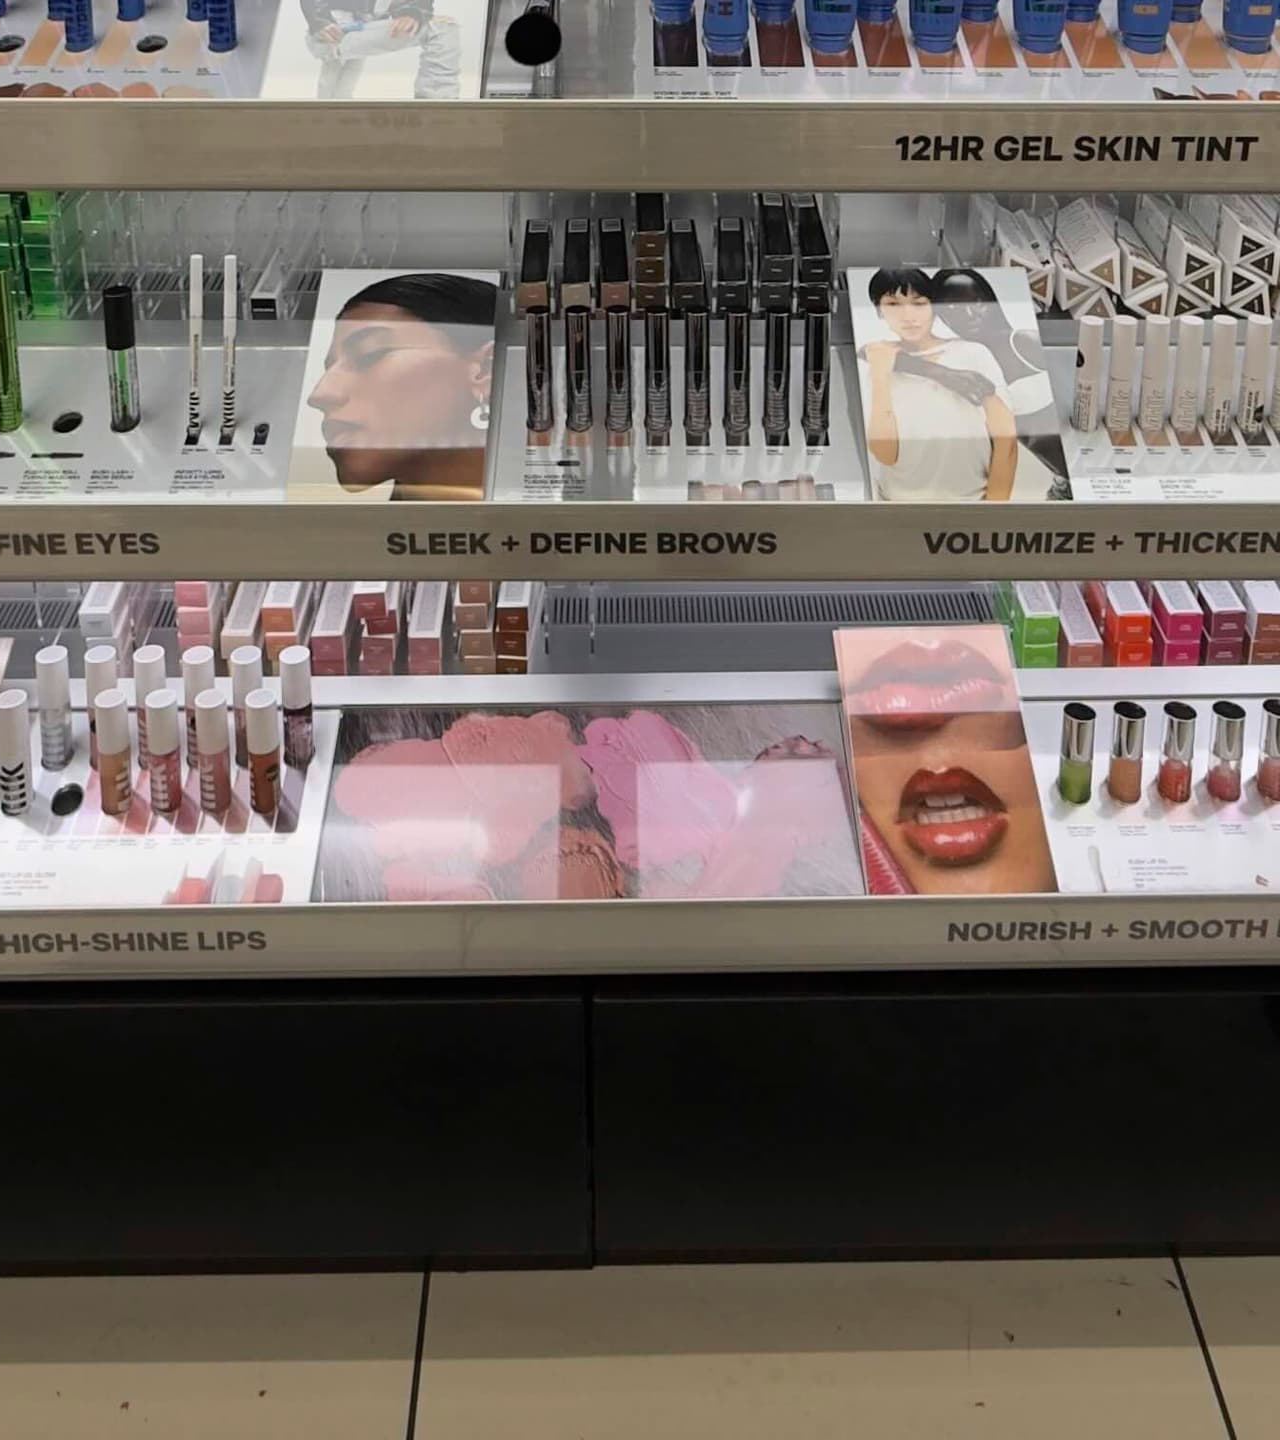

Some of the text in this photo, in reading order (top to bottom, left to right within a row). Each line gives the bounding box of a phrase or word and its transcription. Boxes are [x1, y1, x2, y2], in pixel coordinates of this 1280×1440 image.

[895, 135, 1260, 162] 12HR GEL SKIN TINT
[76, 532, 161, 555] EYES
[386, 532, 778, 555] SLEEK + DEFINE BROWS
[923, 531, 1096, 555] VOLUMIZE
[1105, 534, 1124, 551] +
[197, 930, 267, 951] LIPS
[947, 921, 1092, 943] NOURISH
[1101, 923, 1119, 938] +
[1128, 919, 1269, 941] SMOOTH
